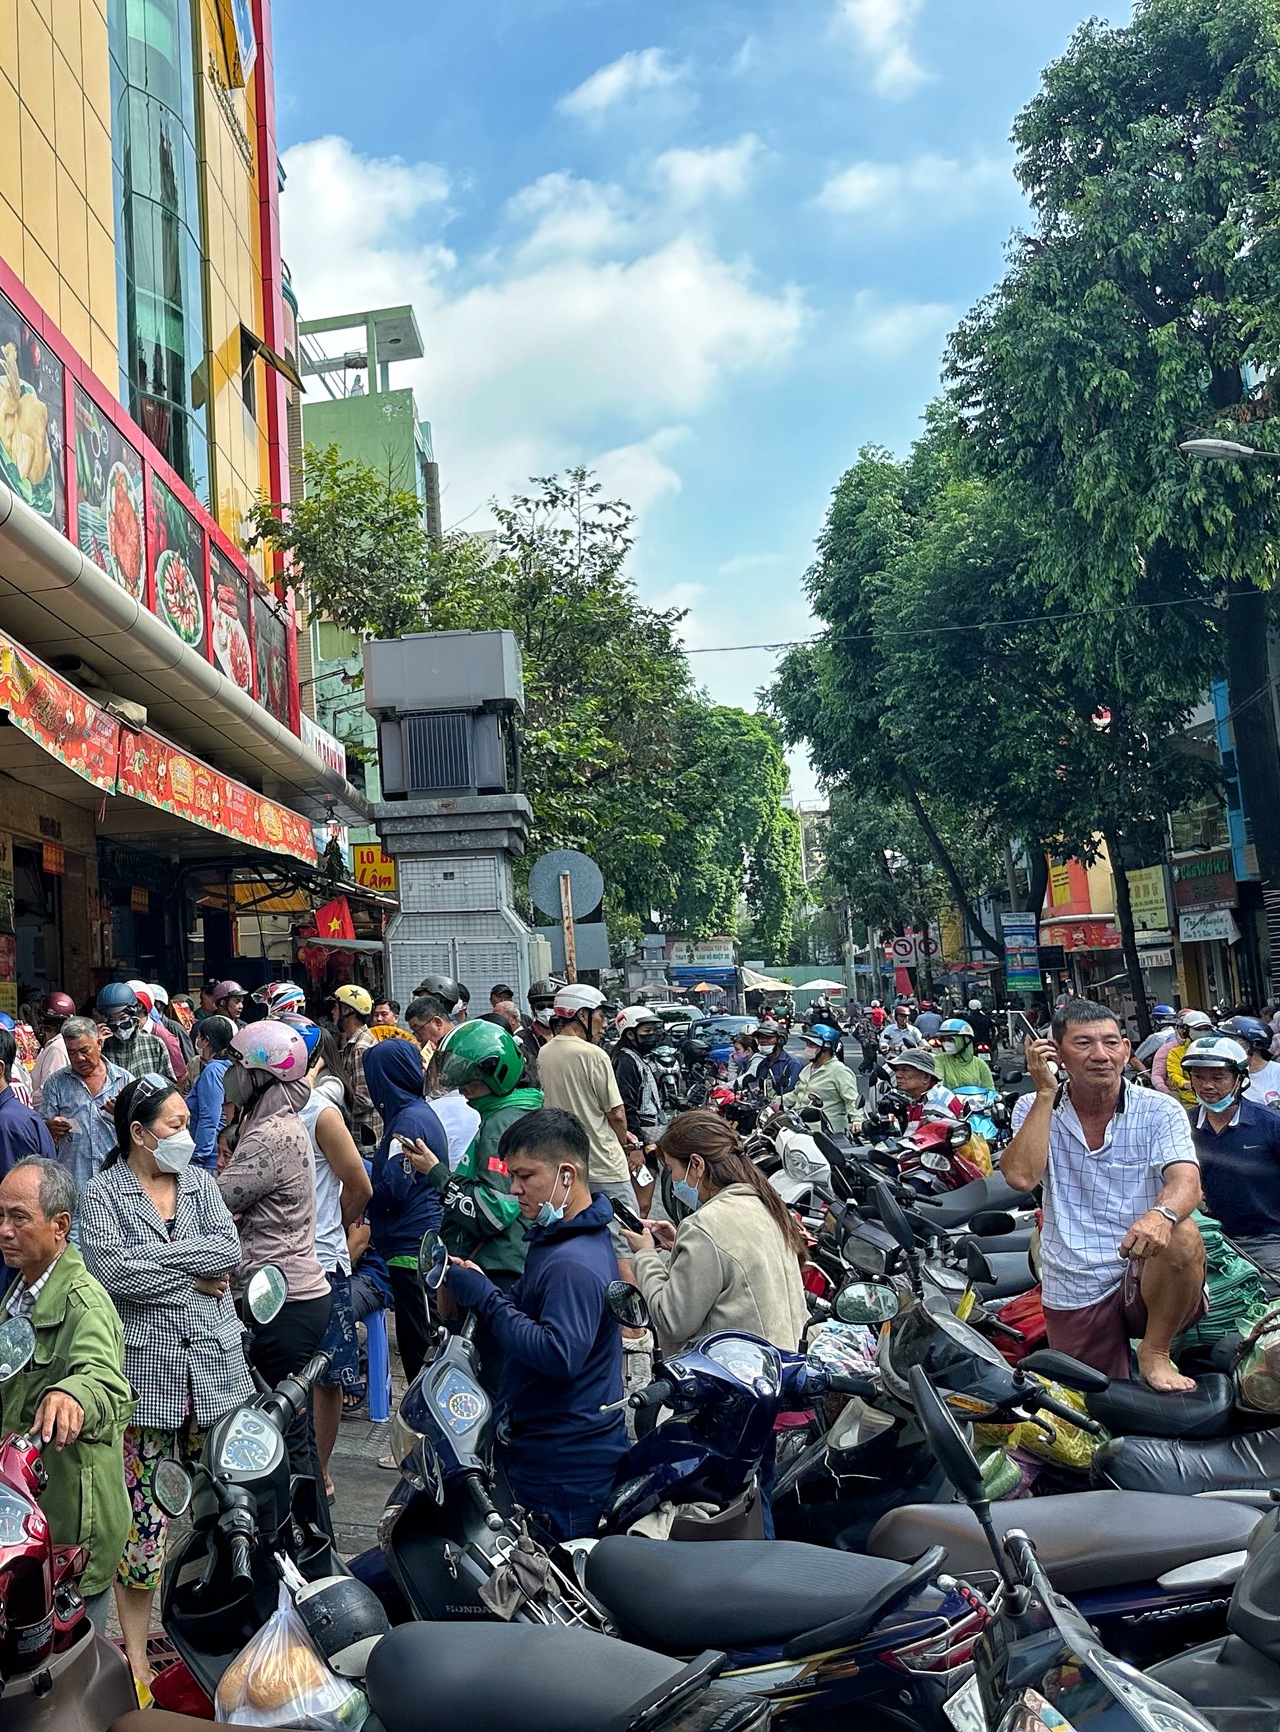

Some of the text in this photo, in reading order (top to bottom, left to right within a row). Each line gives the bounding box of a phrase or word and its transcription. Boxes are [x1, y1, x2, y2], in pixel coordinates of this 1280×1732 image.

[360, 848, 374, 864] LÒ
[359, 868, 391, 889] Lâm
[445, 1605, 492, 1614] HONDA
